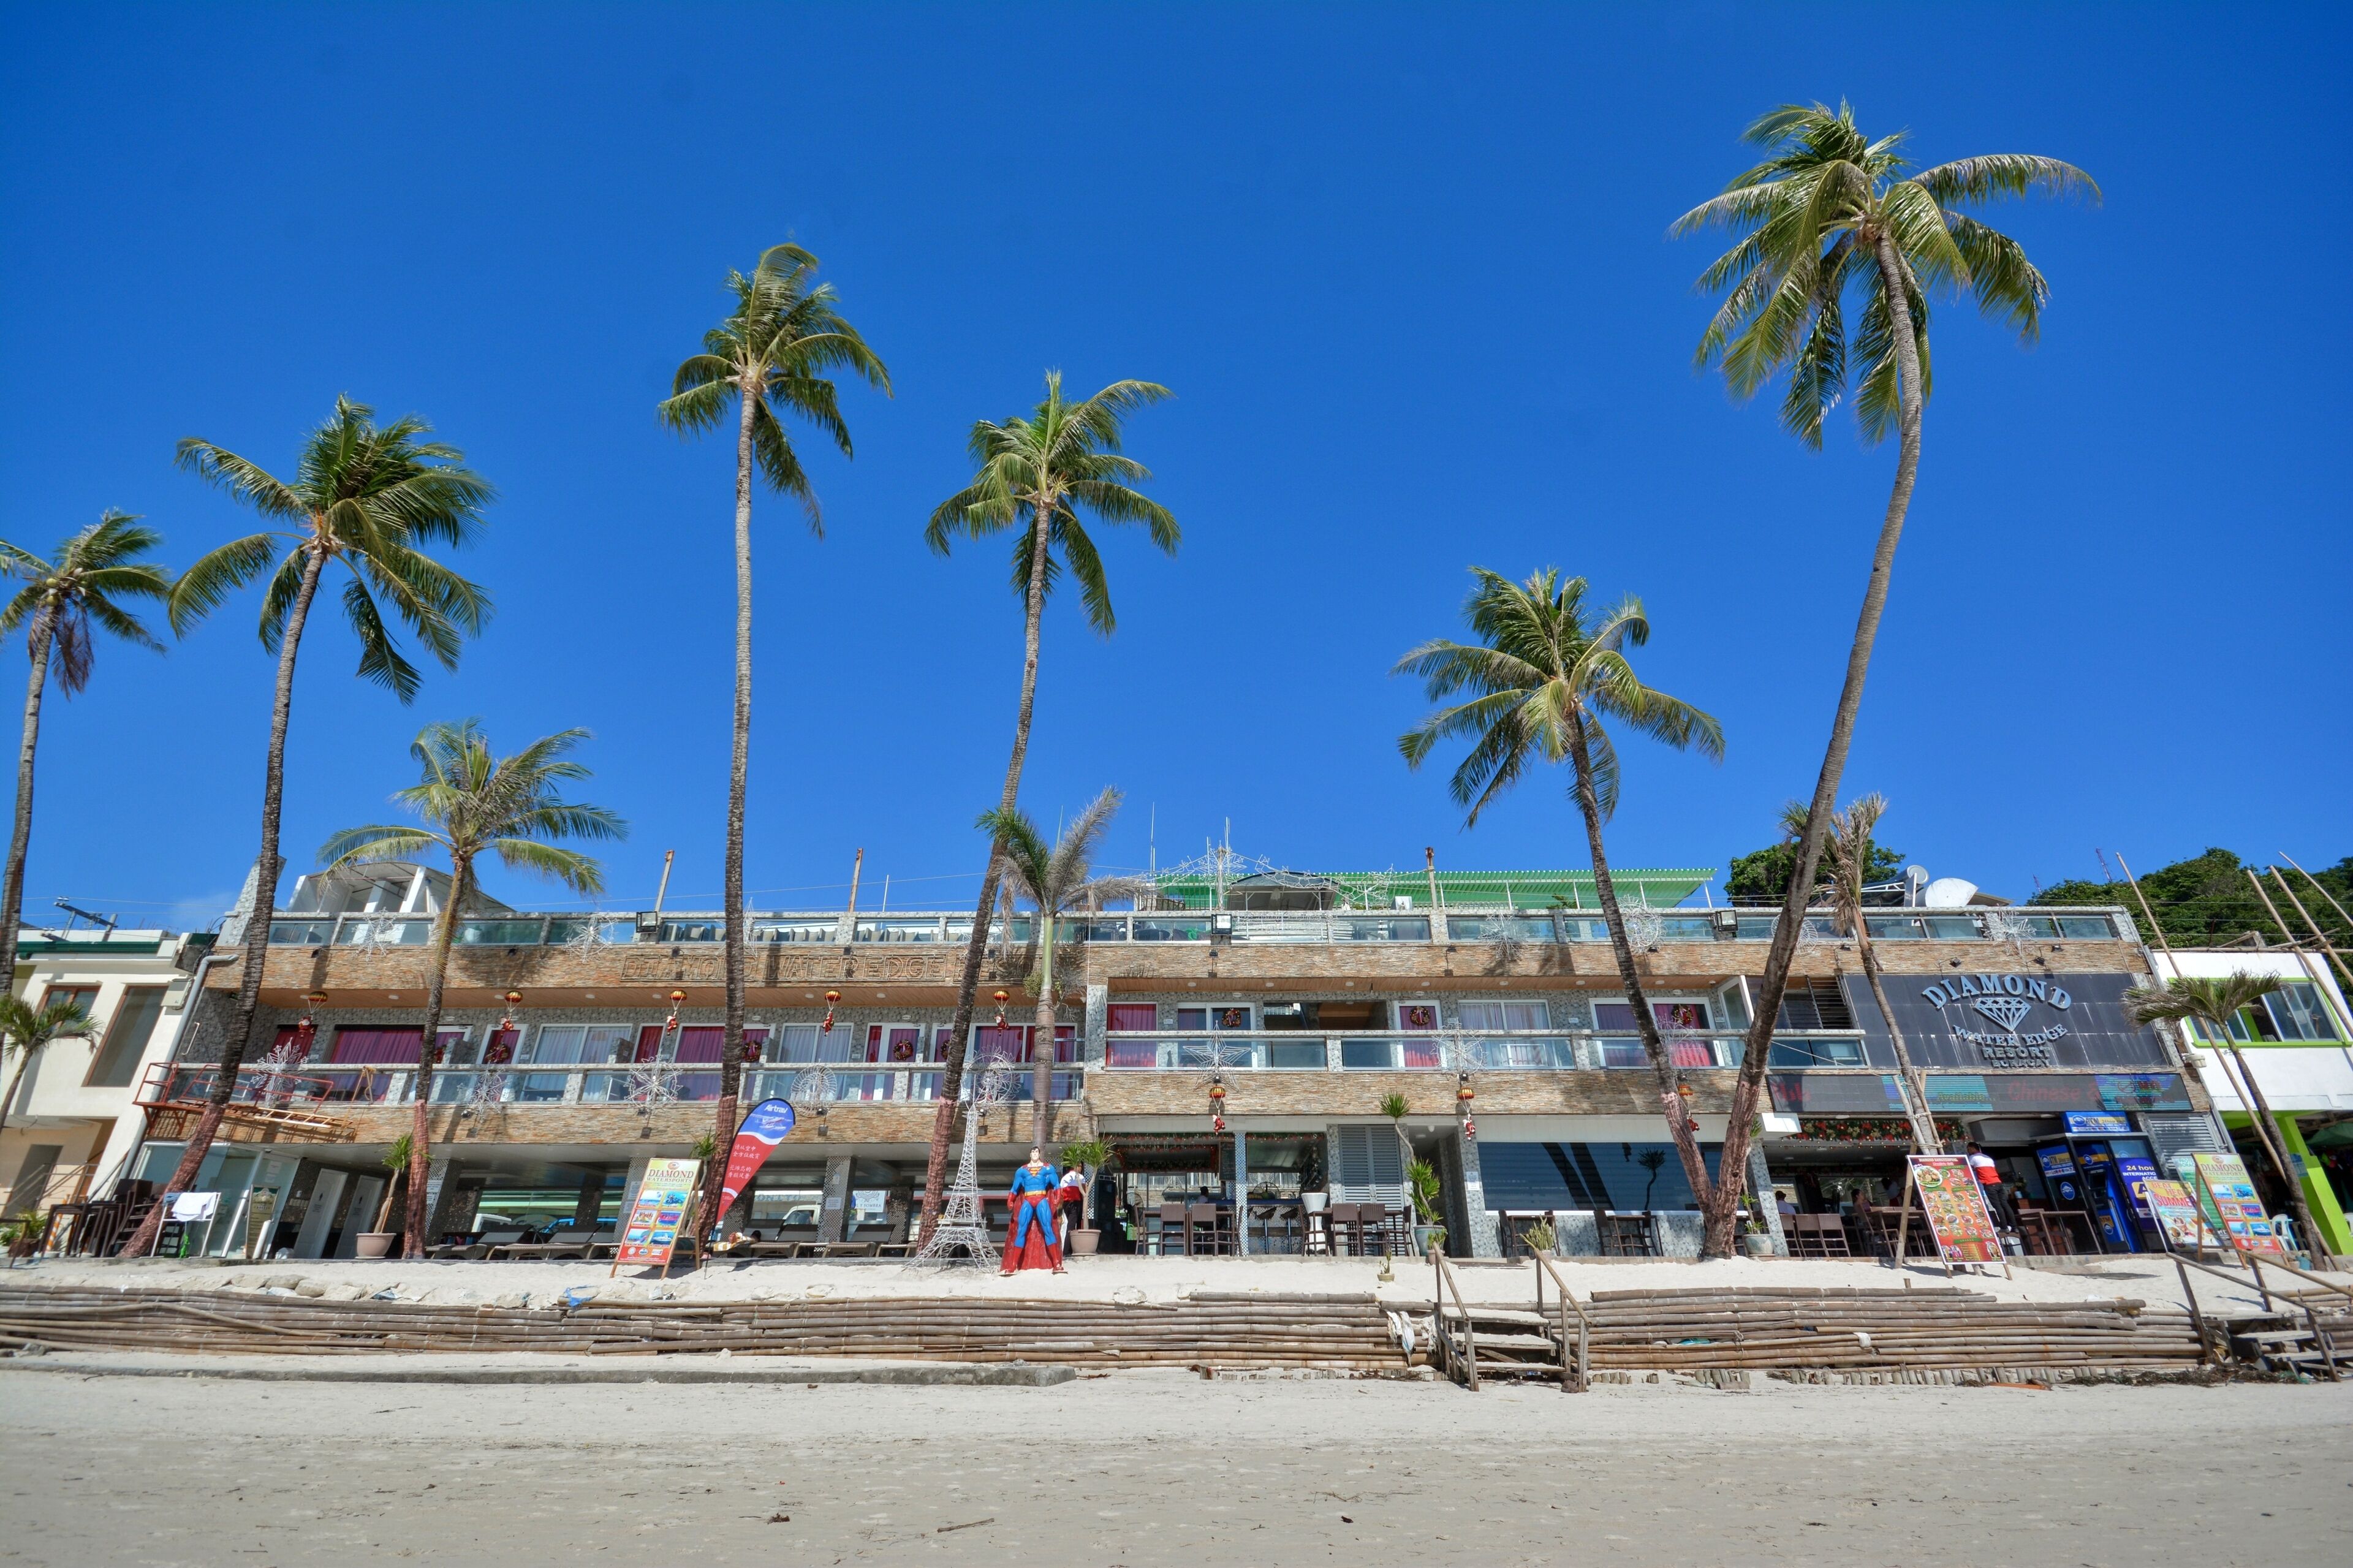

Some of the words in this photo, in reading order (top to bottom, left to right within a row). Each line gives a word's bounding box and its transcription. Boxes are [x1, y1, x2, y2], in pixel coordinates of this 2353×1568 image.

[862, 955, 945, 980] EDGE
[1921, 974, 2072, 1010] DIAMOND
[1952, 1025, 2020, 1047] WATER
[2024, 1023, 2068, 1046] EDGE
[1982, 1047, 2051, 1059] RESORT
[648, 1170, 694, 1178] DIAMOND
[2154, 1193, 2196, 1206] SUMMER
